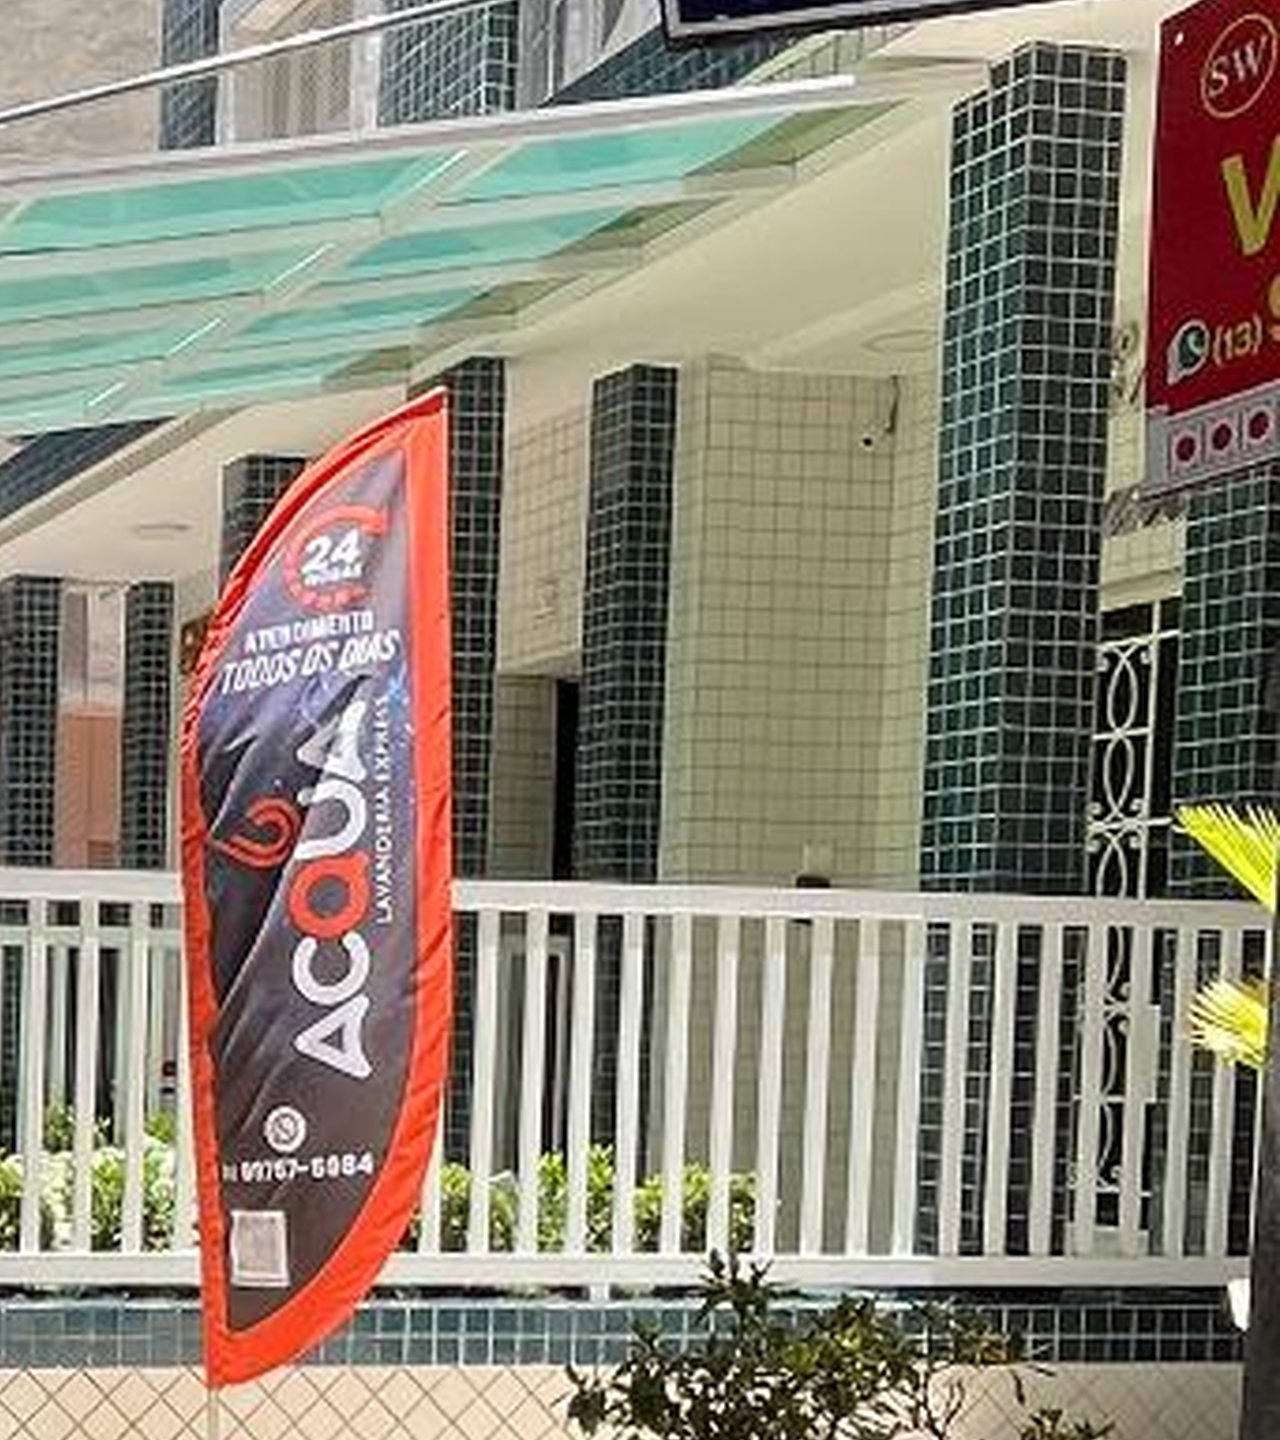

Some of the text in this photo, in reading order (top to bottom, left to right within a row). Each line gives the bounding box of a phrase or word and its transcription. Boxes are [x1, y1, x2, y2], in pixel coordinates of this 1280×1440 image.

[1212, 312, 1263, 368] (13)
[300, 527, 362, 574] 24
[244, 610, 374, 654] ATENDIMENTO
[220, 629, 401, 696] TODOS OS DIAS
[288, 699, 374, 1080] ACQUA
